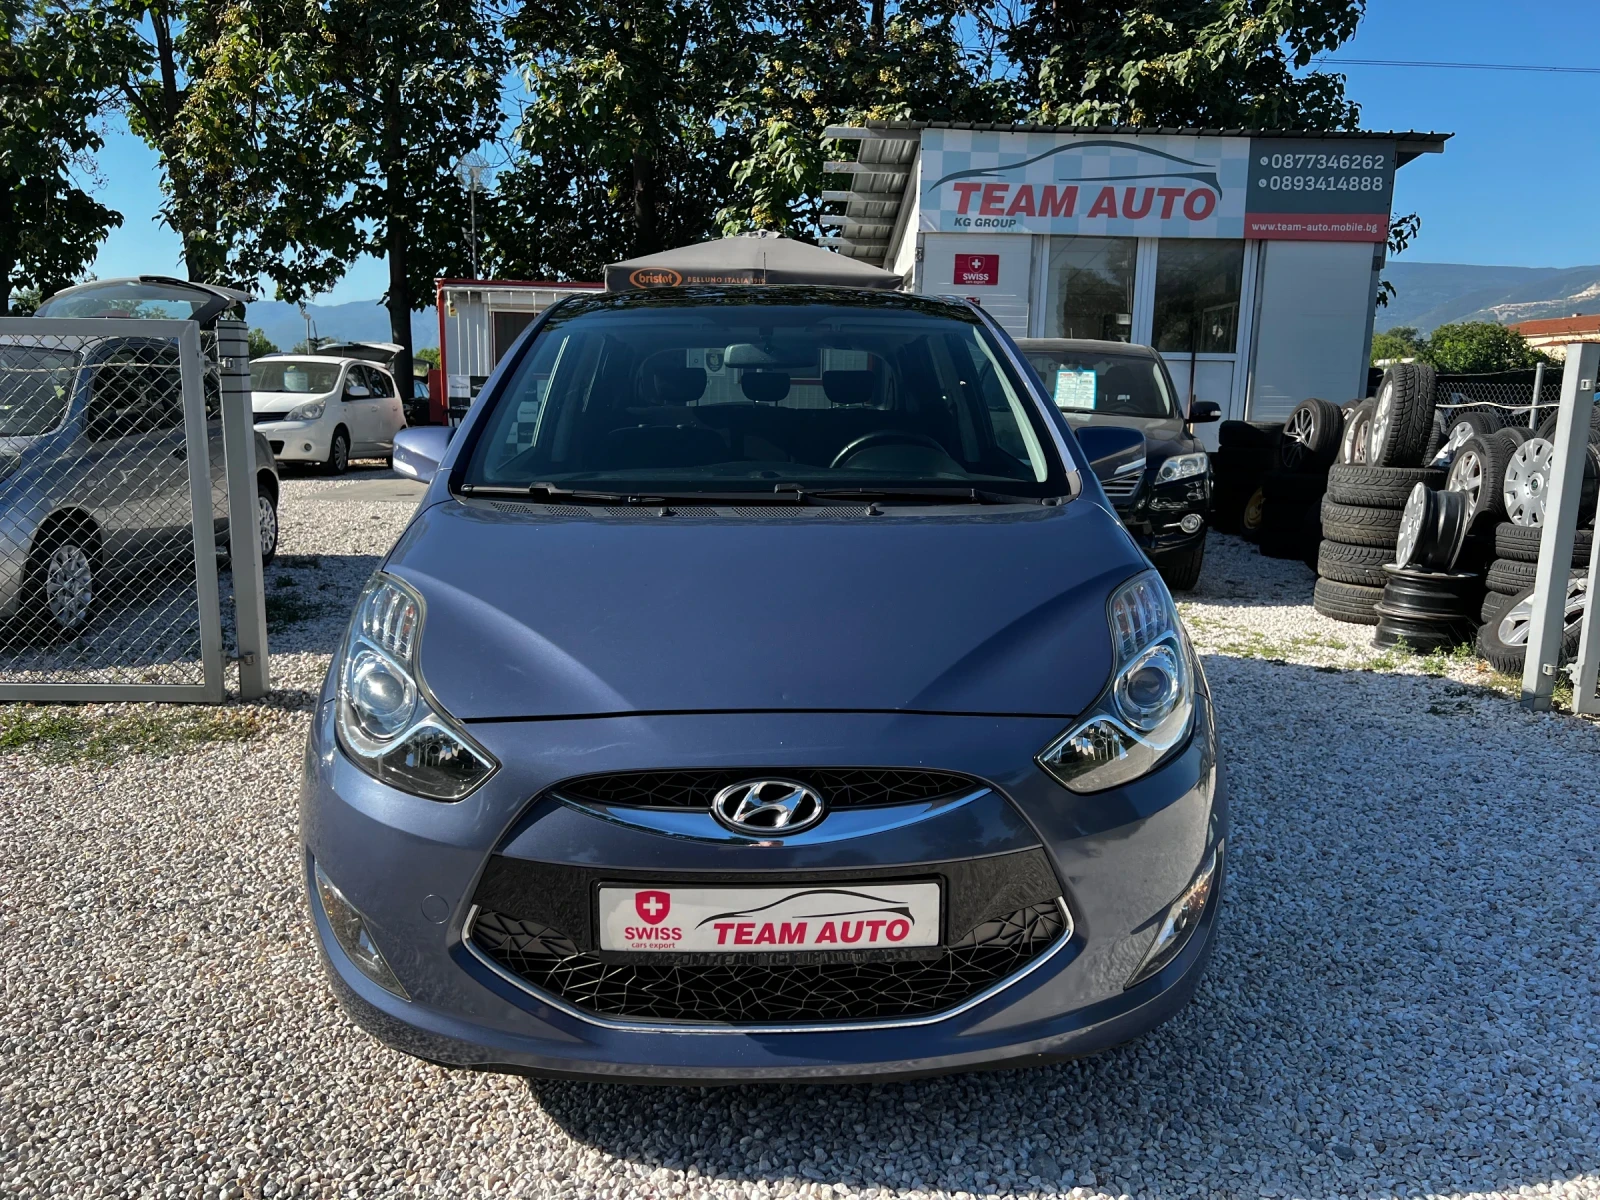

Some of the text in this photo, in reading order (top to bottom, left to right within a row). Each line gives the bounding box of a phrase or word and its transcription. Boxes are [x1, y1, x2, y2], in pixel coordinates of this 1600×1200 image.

[1271, 154, 1384, 170] 0877346262
[1269, 176, 1383, 191] 0893414888
[953, 182, 1216, 221] TEAM AUTO
[954, 217, 1017, 228] KG GROUP
[1251, 222, 1378, 233] www.team-auto.mobile.bg
[639, 273, 673, 284] bristot
[724, 276, 749, 284] ITALIA
[962, 273, 989, 281] SWISS
[624, 926, 683, 941] SWISS
[713, 918, 910, 945] TEAM AUTO
[649, 942, 676, 950] export
